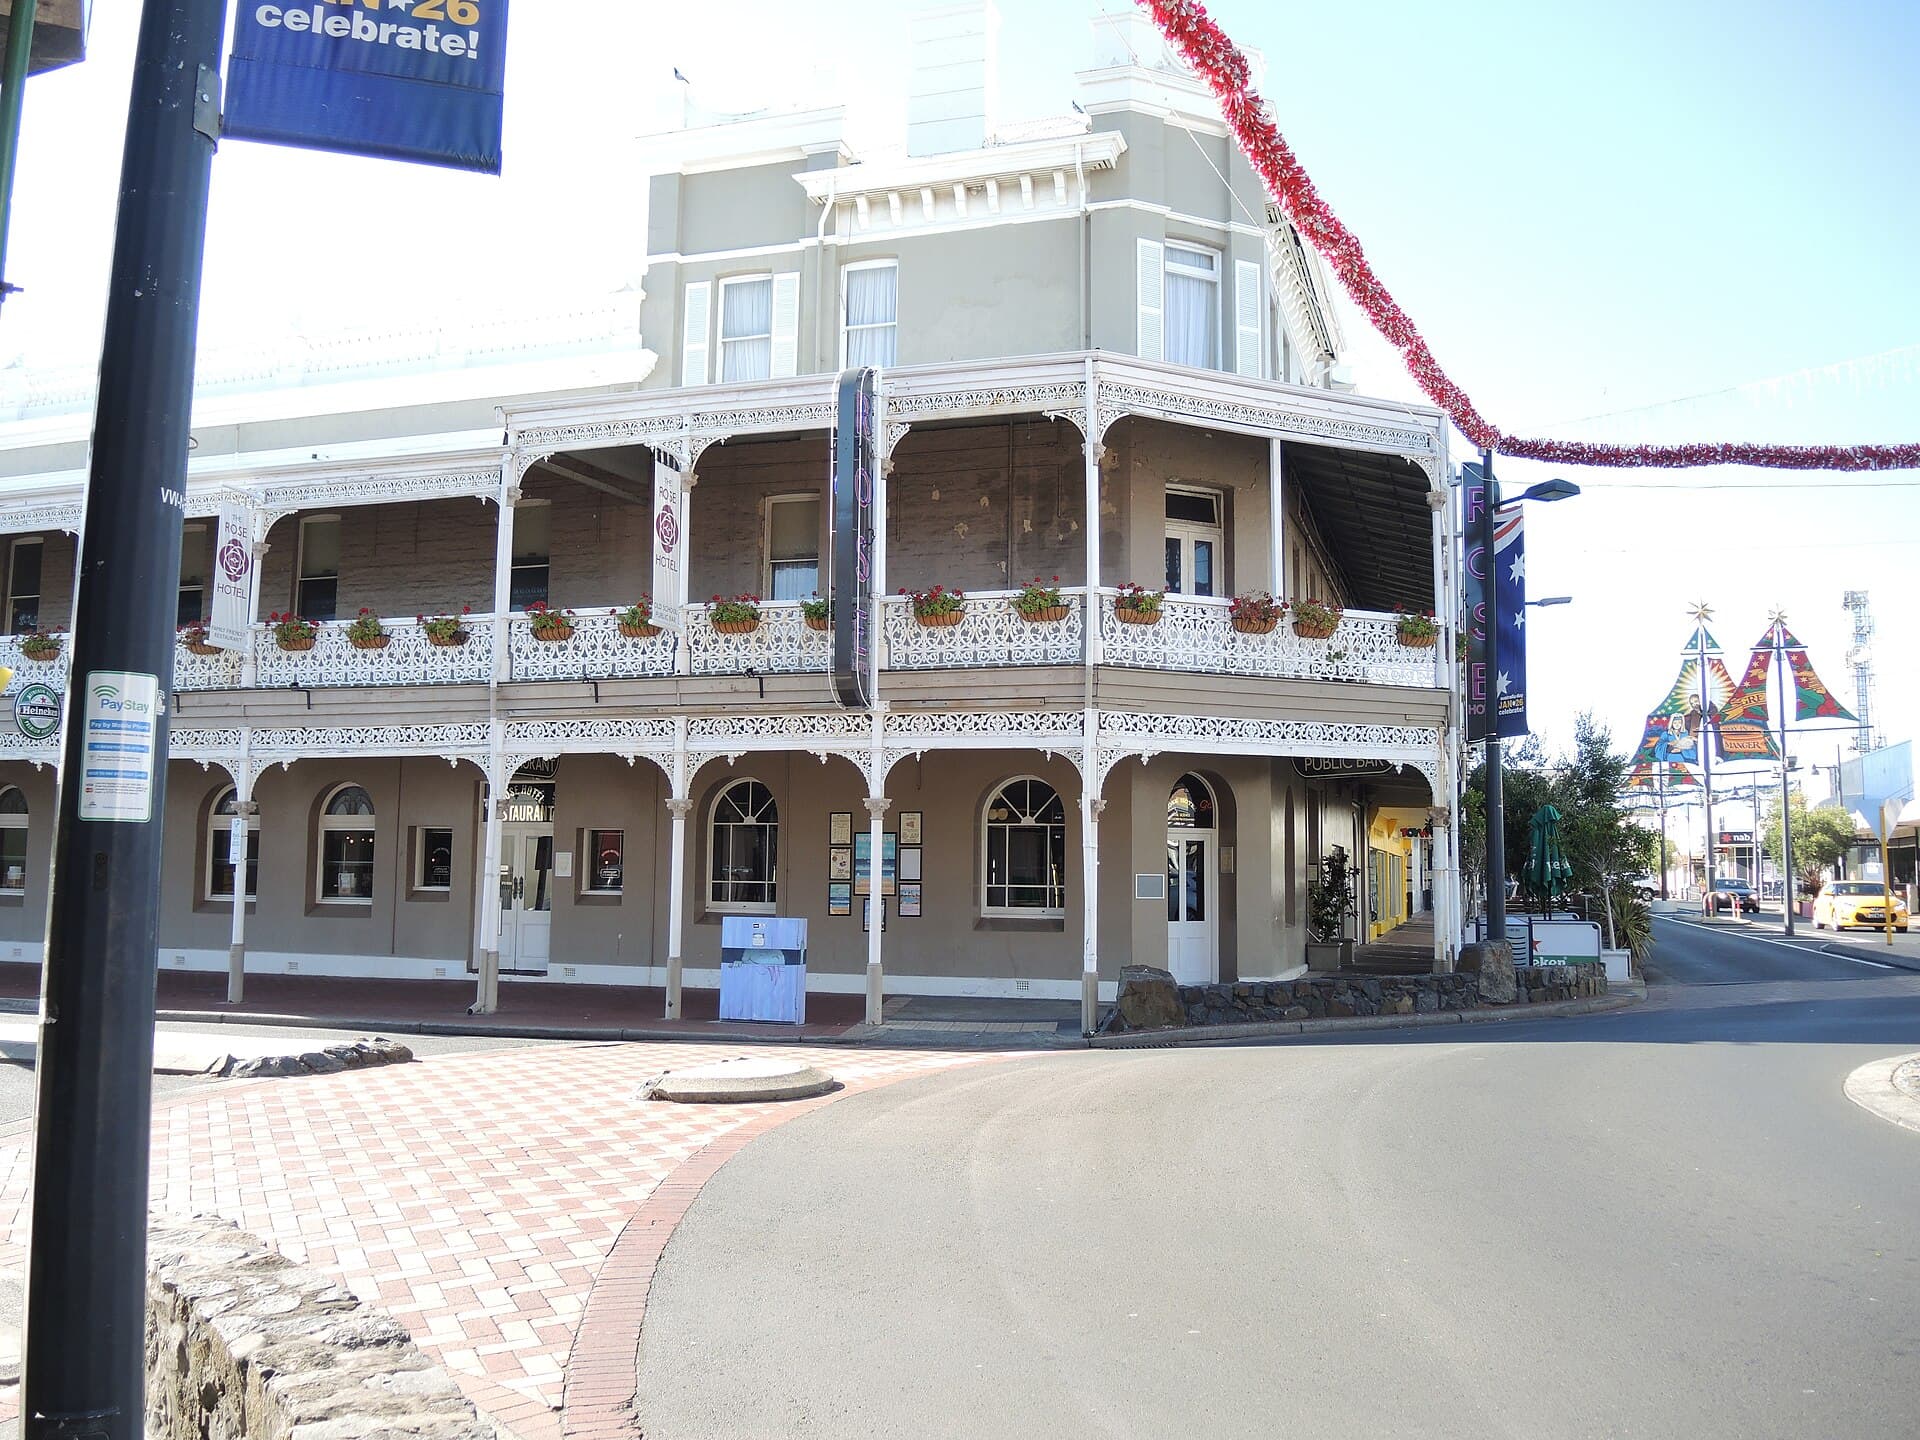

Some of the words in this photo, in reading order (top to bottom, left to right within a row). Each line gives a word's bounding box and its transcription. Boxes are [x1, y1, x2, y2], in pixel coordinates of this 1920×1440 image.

[255, 5, 480, 60] celebrate!
[663, 477, 673, 488] THE
[658, 487, 678, 504] ROSE
[231, 513, 243, 524] THE
[224, 521, 248, 539] ROSE
[655, 553, 679, 573] HOTEL
[216, 583, 248, 600] HOTEL
[100, 698, 150, 713] PayStay
[1498, 700, 1513, 709] JAN
[1498, 706, 1524, 716] celebrate!
[1725, 741, 1761, 750] MANGER
[1304, 757, 1353, 772] PUBLIC
[1356, 758, 1384, 769] BAR
[1733, 833, 1752, 842] nab
